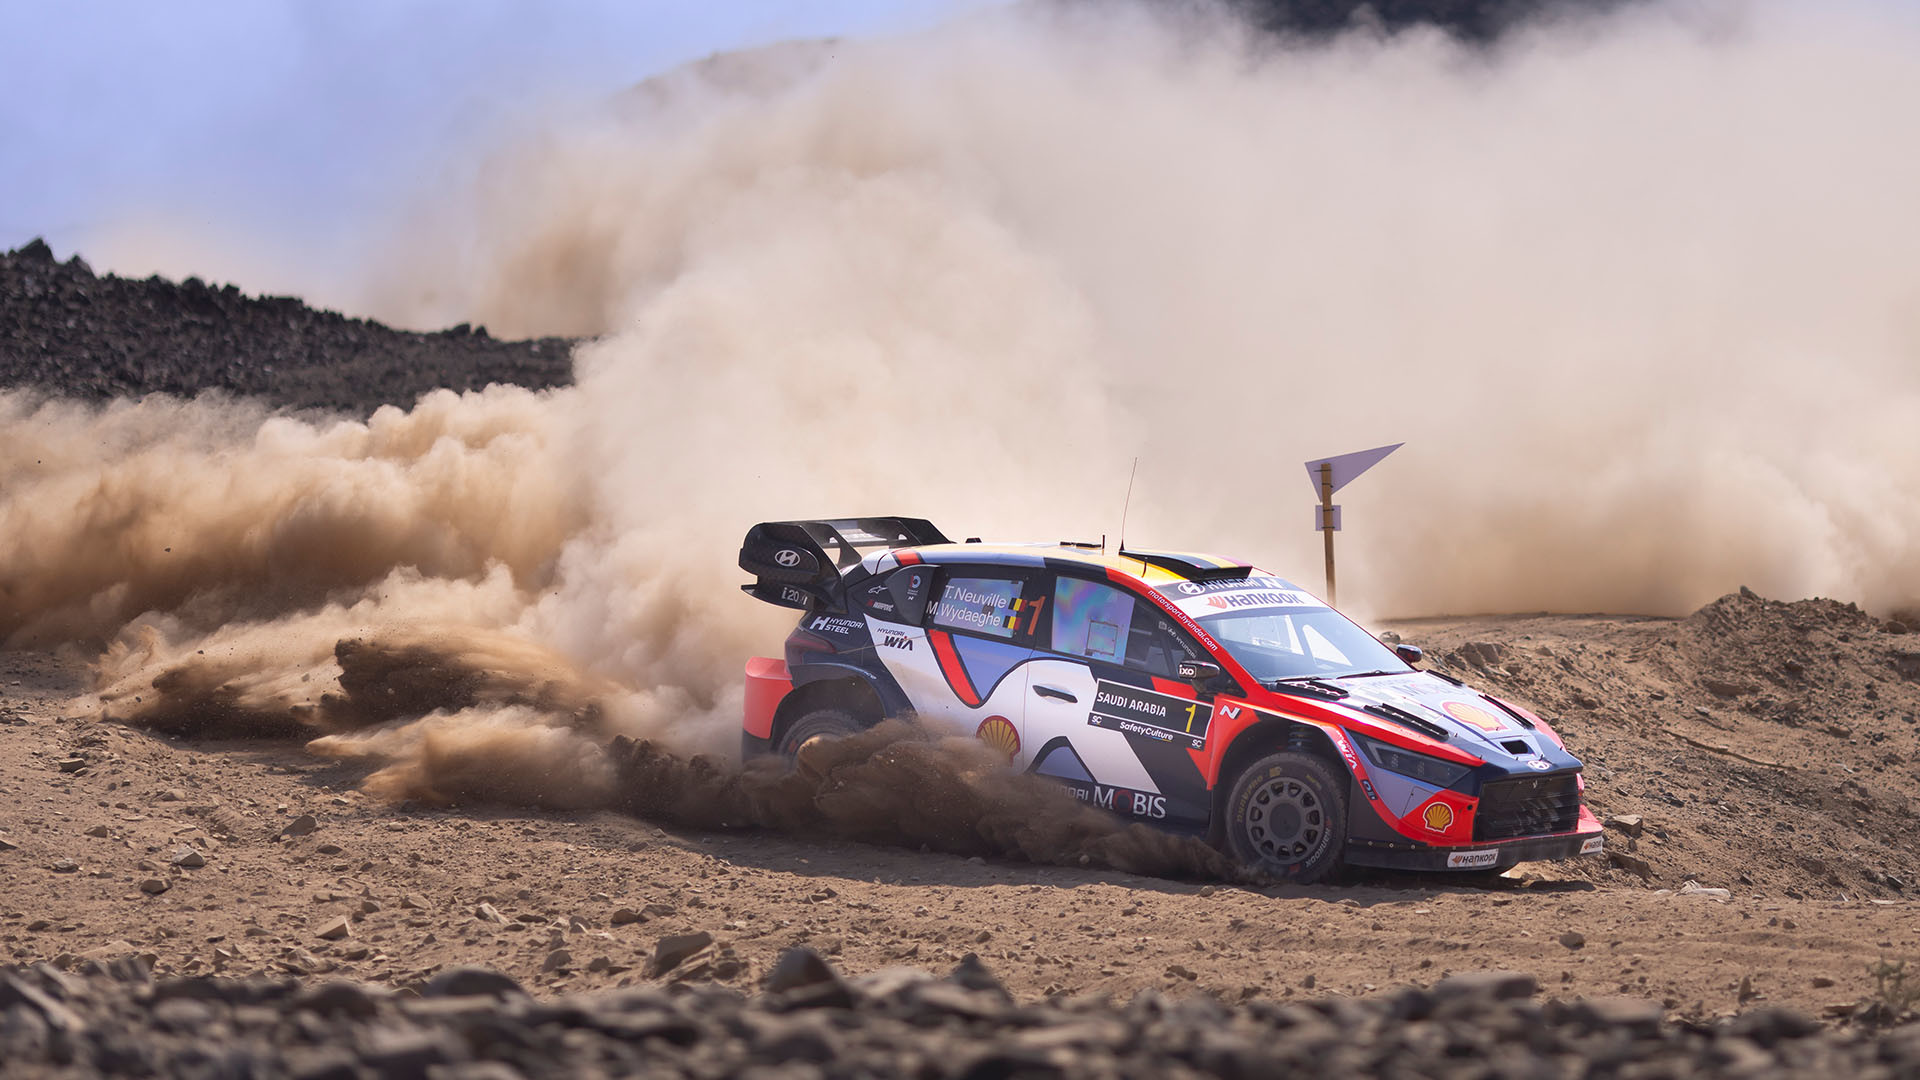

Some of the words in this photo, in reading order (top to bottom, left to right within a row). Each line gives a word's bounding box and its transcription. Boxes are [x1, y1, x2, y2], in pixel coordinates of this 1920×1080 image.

[829, 617, 864, 629] HYUNDAI
[1029, 596, 1046, 636] 1
[1147, 589, 1218, 652] motorsport.hyundai.com
[824, 625, 849, 635] STEEL
[877, 627, 905, 636] HYUNDAI
[883, 636, 913, 651] WIA
[1097, 691, 1128, 708] SAUDI
[1129, 700, 1167, 717] ARABIA
[1091, 715, 1102, 724] SC
[1185, 704, 1196, 733] 1
[1120, 721, 1174, 740] SafetyCulture
[1191, 739, 1202, 748] SC
[1093, 786, 1167, 819] MOBIS
